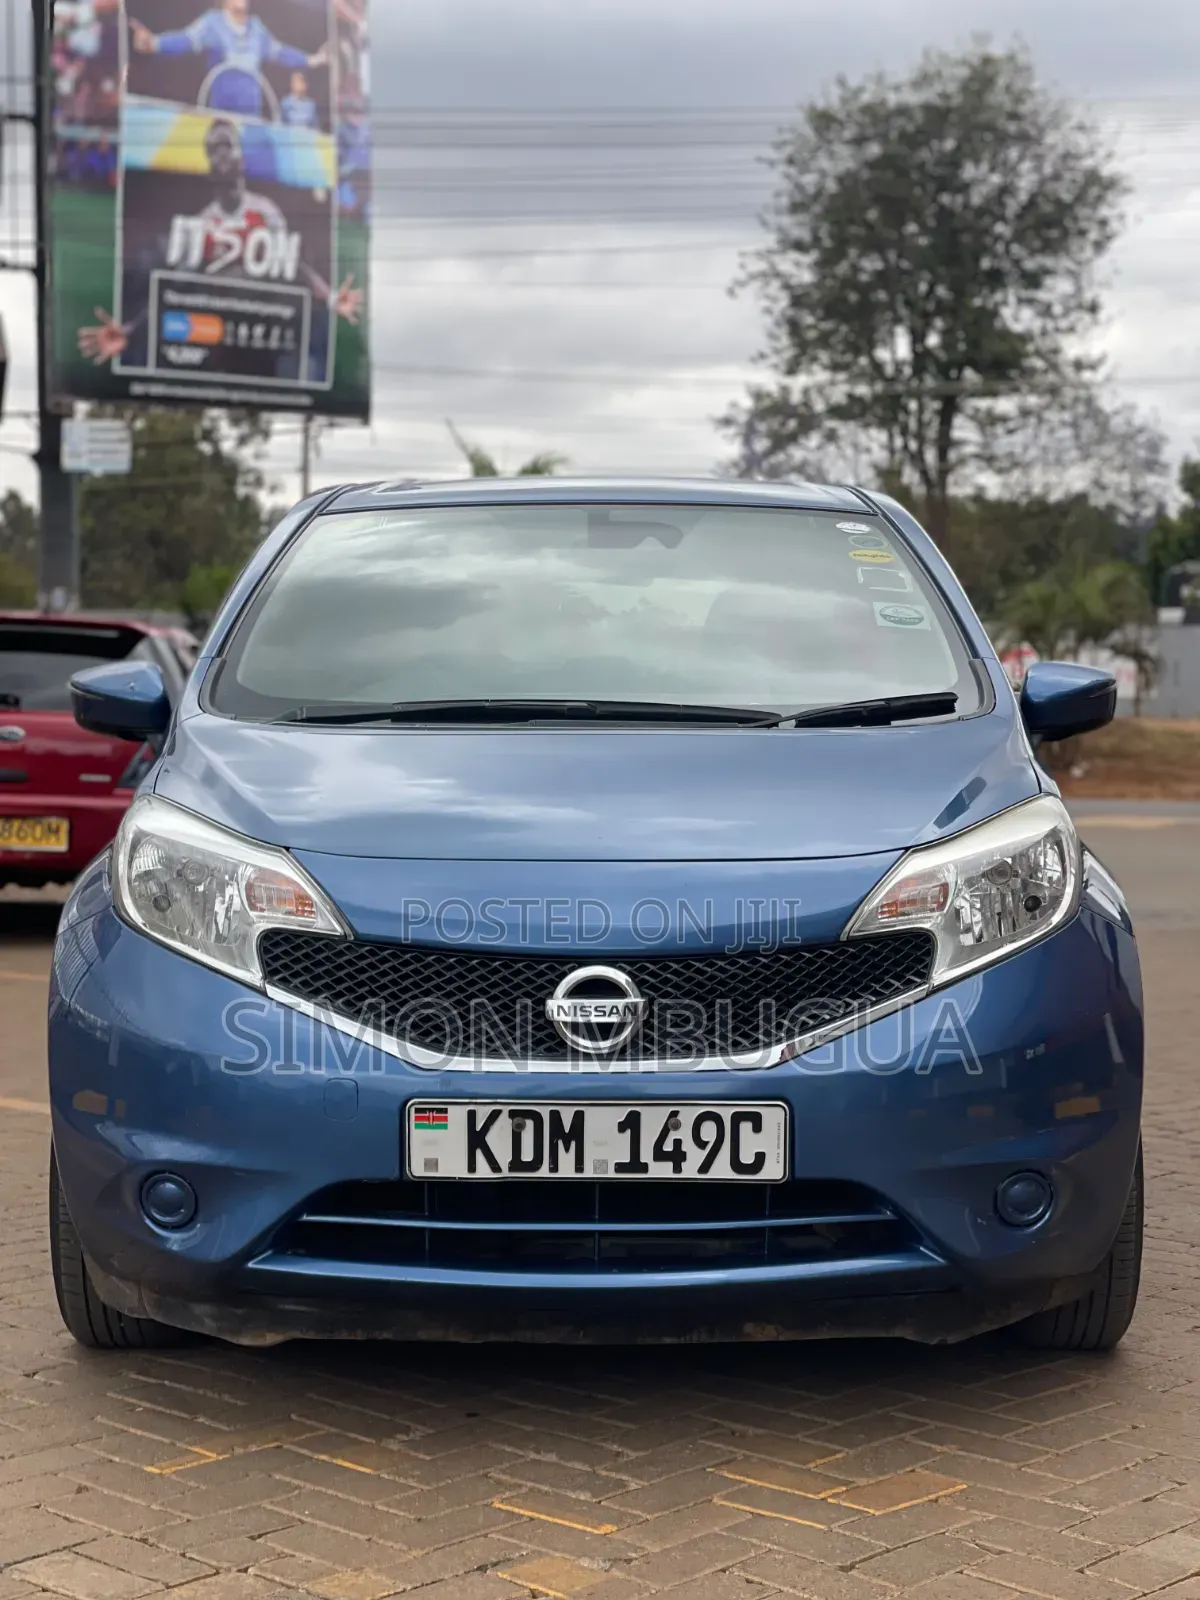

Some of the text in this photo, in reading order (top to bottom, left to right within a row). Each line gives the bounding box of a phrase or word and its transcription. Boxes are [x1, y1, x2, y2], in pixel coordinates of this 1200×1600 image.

[556, 1005, 638, 1018] NISSAN
[466, 1109, 585, 1174] KDM
[614, 1109, 767, 1175] 149C
